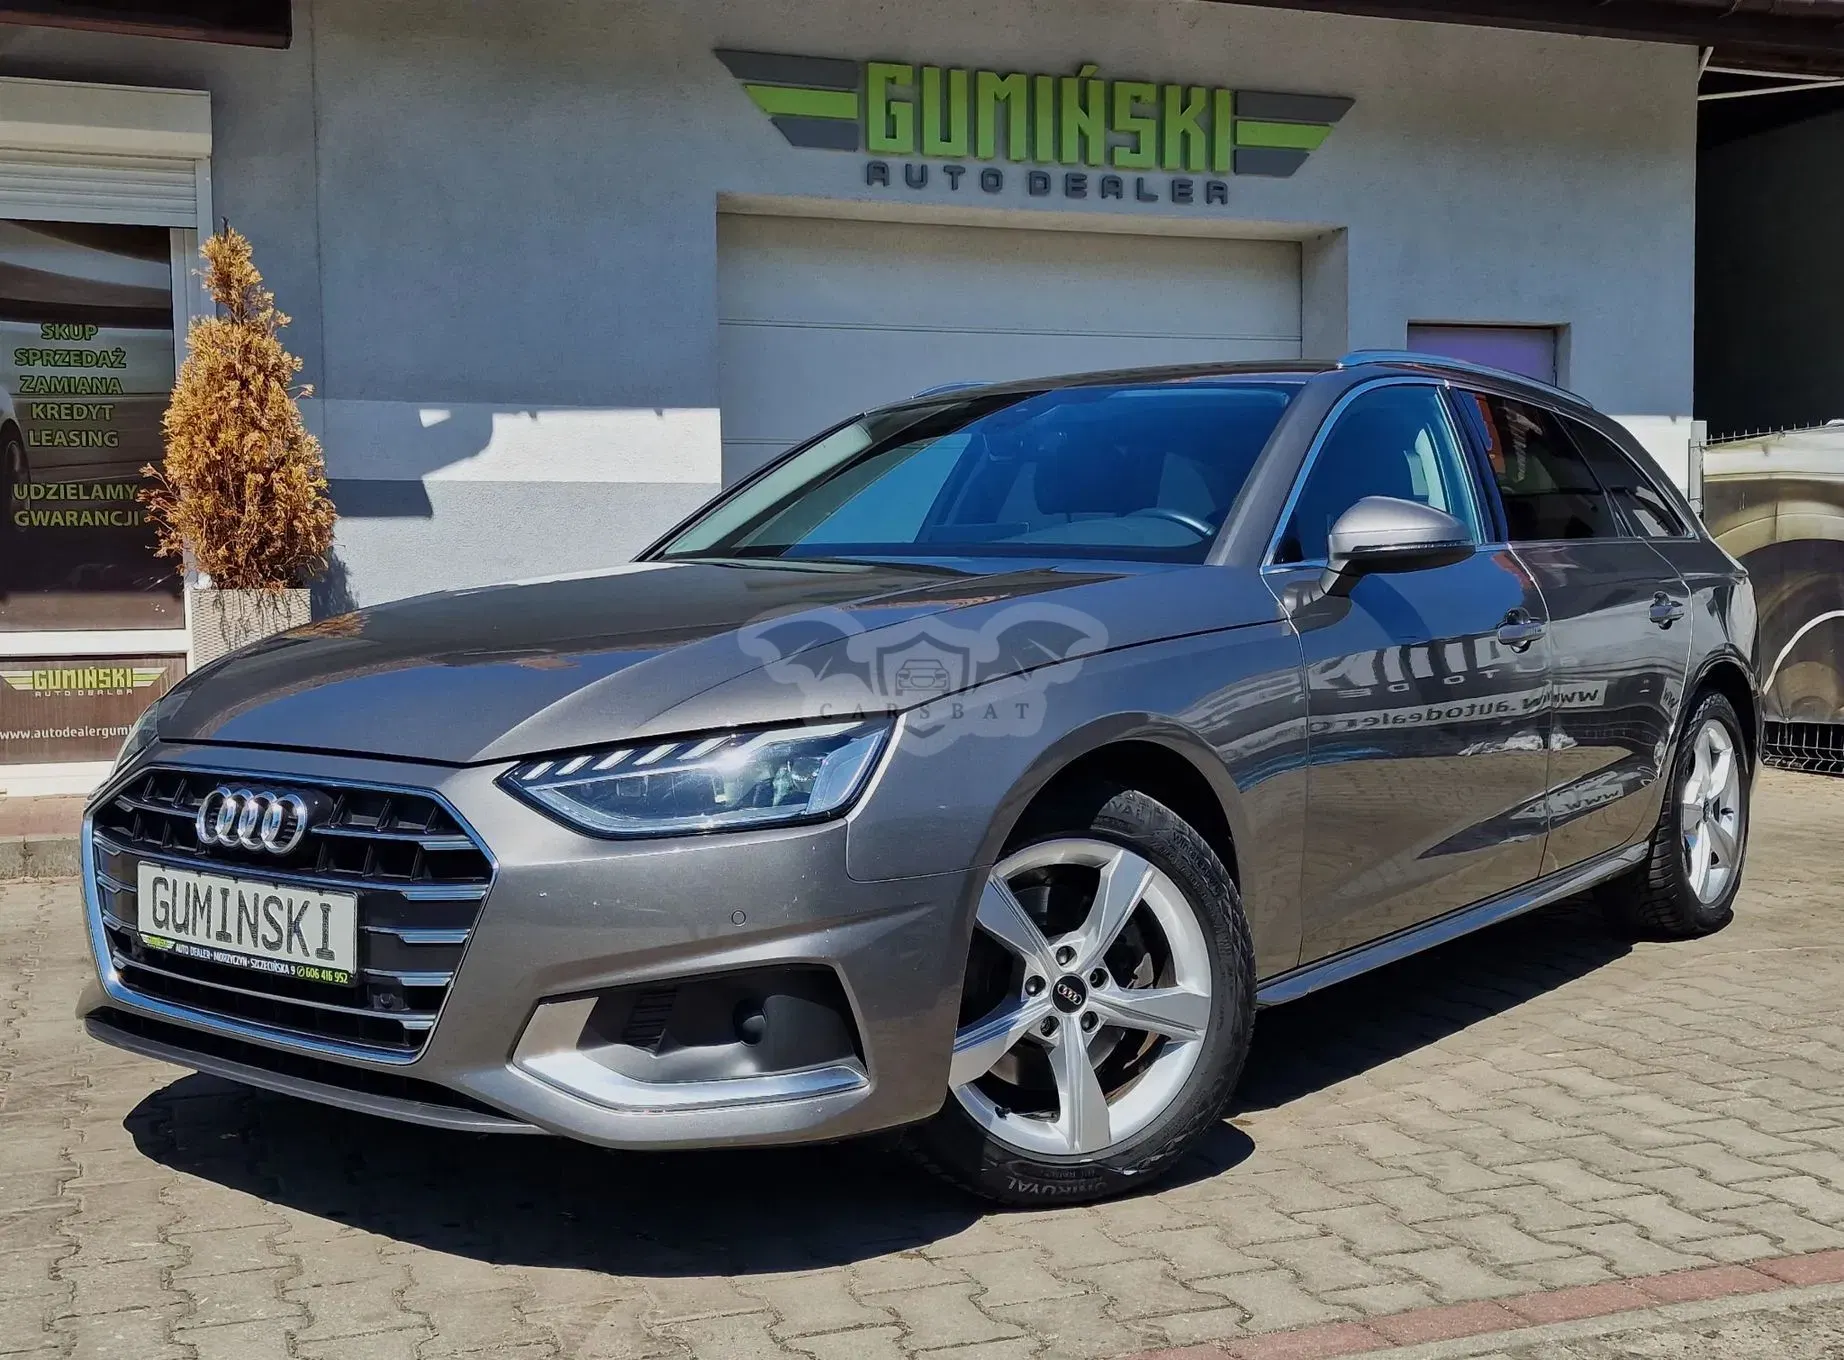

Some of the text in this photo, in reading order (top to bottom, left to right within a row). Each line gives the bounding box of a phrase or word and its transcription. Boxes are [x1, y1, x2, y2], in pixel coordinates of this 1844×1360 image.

[866, 62, 1232, 173] GUMIŃSKI
[866, 161, 1229, 205] AUTO DEALER
[40, 323, 98, 341] SKUP
[14, 348, 126, 368] SPRZEDAŻ
[20, 375, 123, 394] ZAMIANA
[31, 403, 114, 421] KREDYT
[29, 430, 119, 448] LEASING
[13, 484, 138, 500] UDZIELAMY
[14, 510, 139, 527] GWARANCJI
[33, 667, 133, 690] GUMIŃSKI
[151, 876, 336, 962] GUMINSKI
[175, 943, 189, 954] AUTO
[189, 946, 211, 960] DEALER
[290, 965, 296, 975] 9
[305, 967, 319, 979] 606
[320, 969, 333, 981] 416
[334, 972, 349, 984] 952
